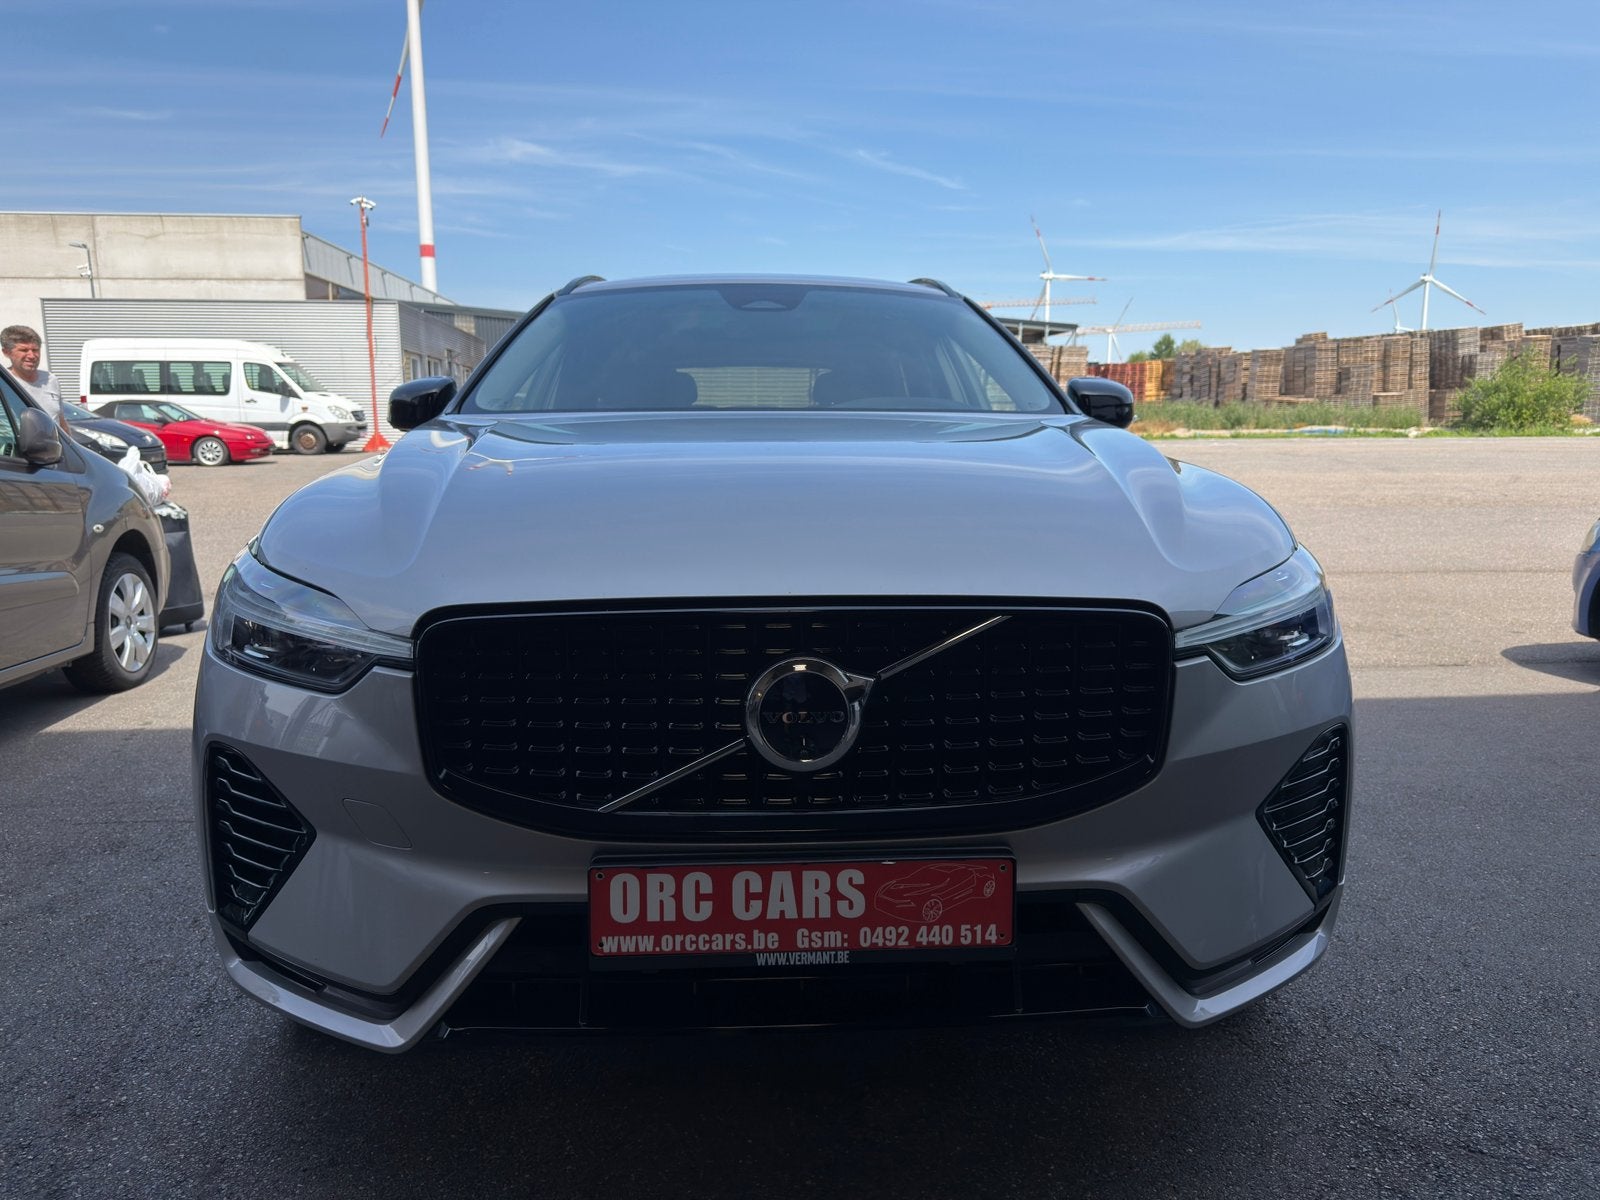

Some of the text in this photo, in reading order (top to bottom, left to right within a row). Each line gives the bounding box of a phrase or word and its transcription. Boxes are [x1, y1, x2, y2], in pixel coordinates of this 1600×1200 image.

[763, 711, 845, 724] VOLVO
[609, 869, 867, 923] ORC CARS
[602, 923, 998, 953] www.orccars.be Gsm: 0492 440 514
[756, 951, 850, 967] WWW.VERMANT.BE
